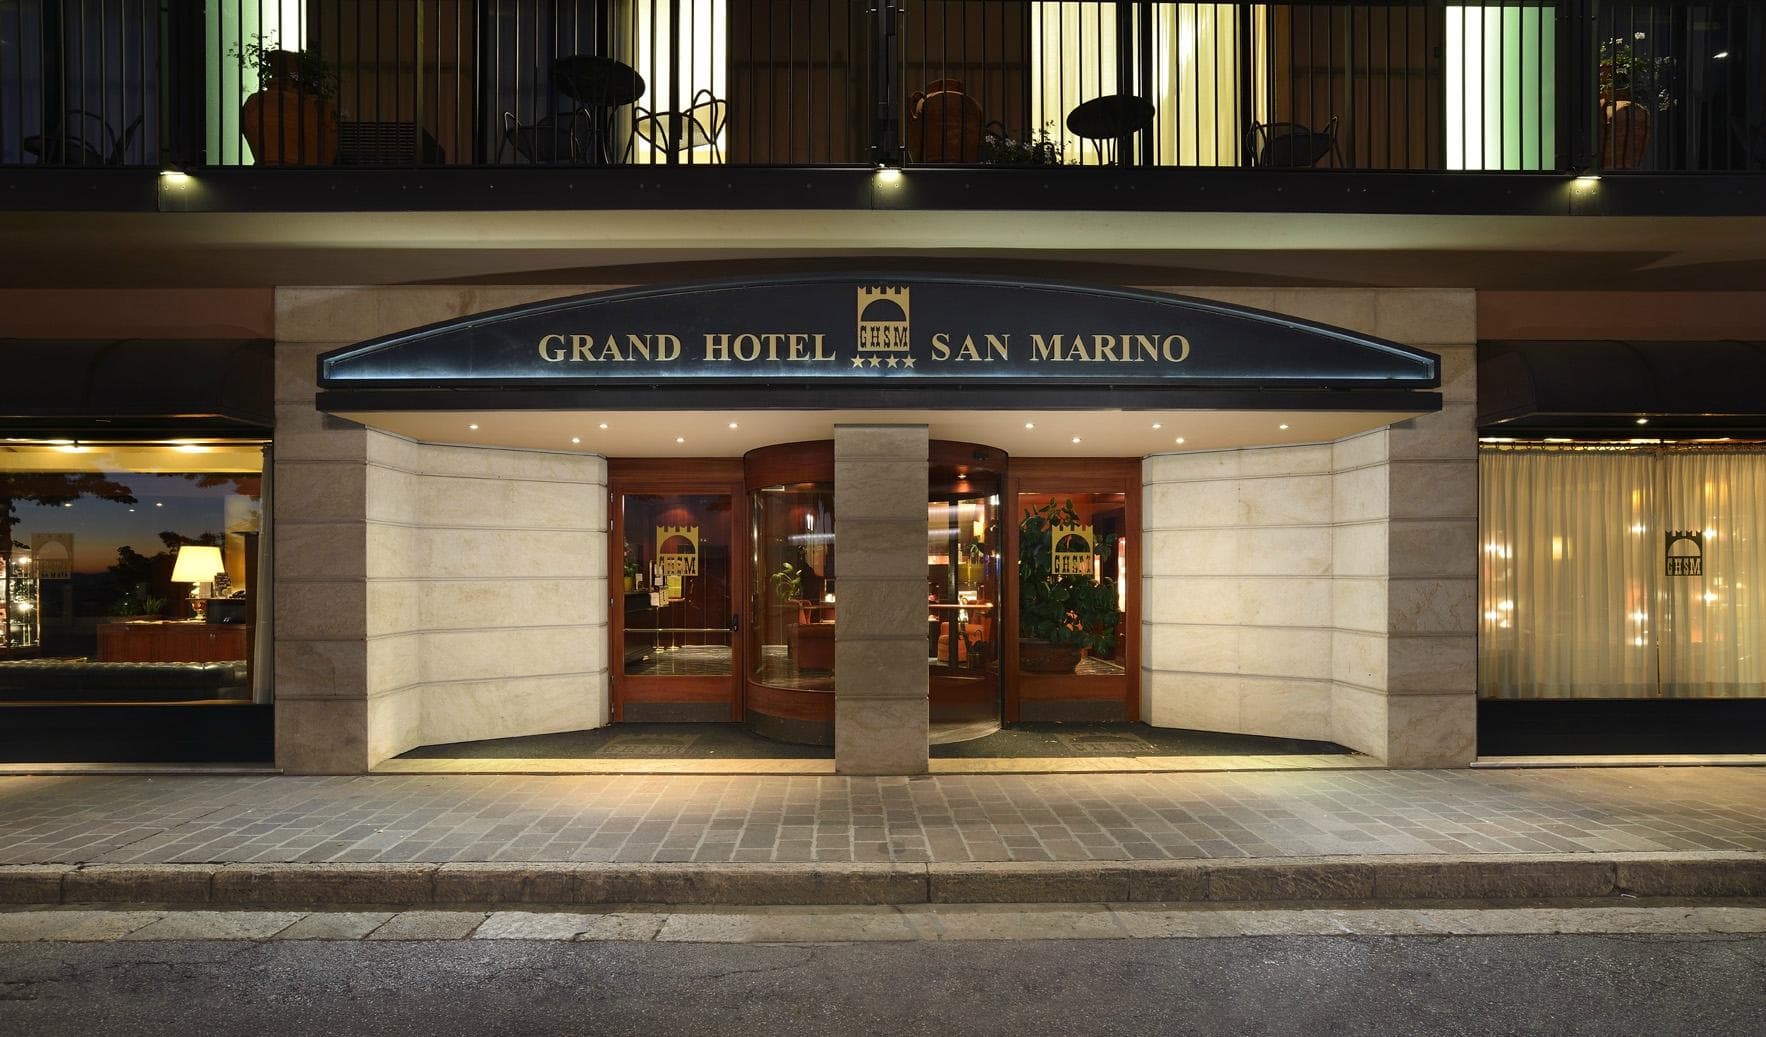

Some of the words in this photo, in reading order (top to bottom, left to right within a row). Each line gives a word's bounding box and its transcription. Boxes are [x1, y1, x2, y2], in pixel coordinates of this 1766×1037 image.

[538, 334, 682, 361] GRAND
[703, 334, 837, 361] HOTEL
[860, 325, 908, 348] GHSM
[931, 333, 1011, 362] SAN
[1030, 334, 1191, 362] MARINO
[1668, 558, 1700, 575] GHSM
